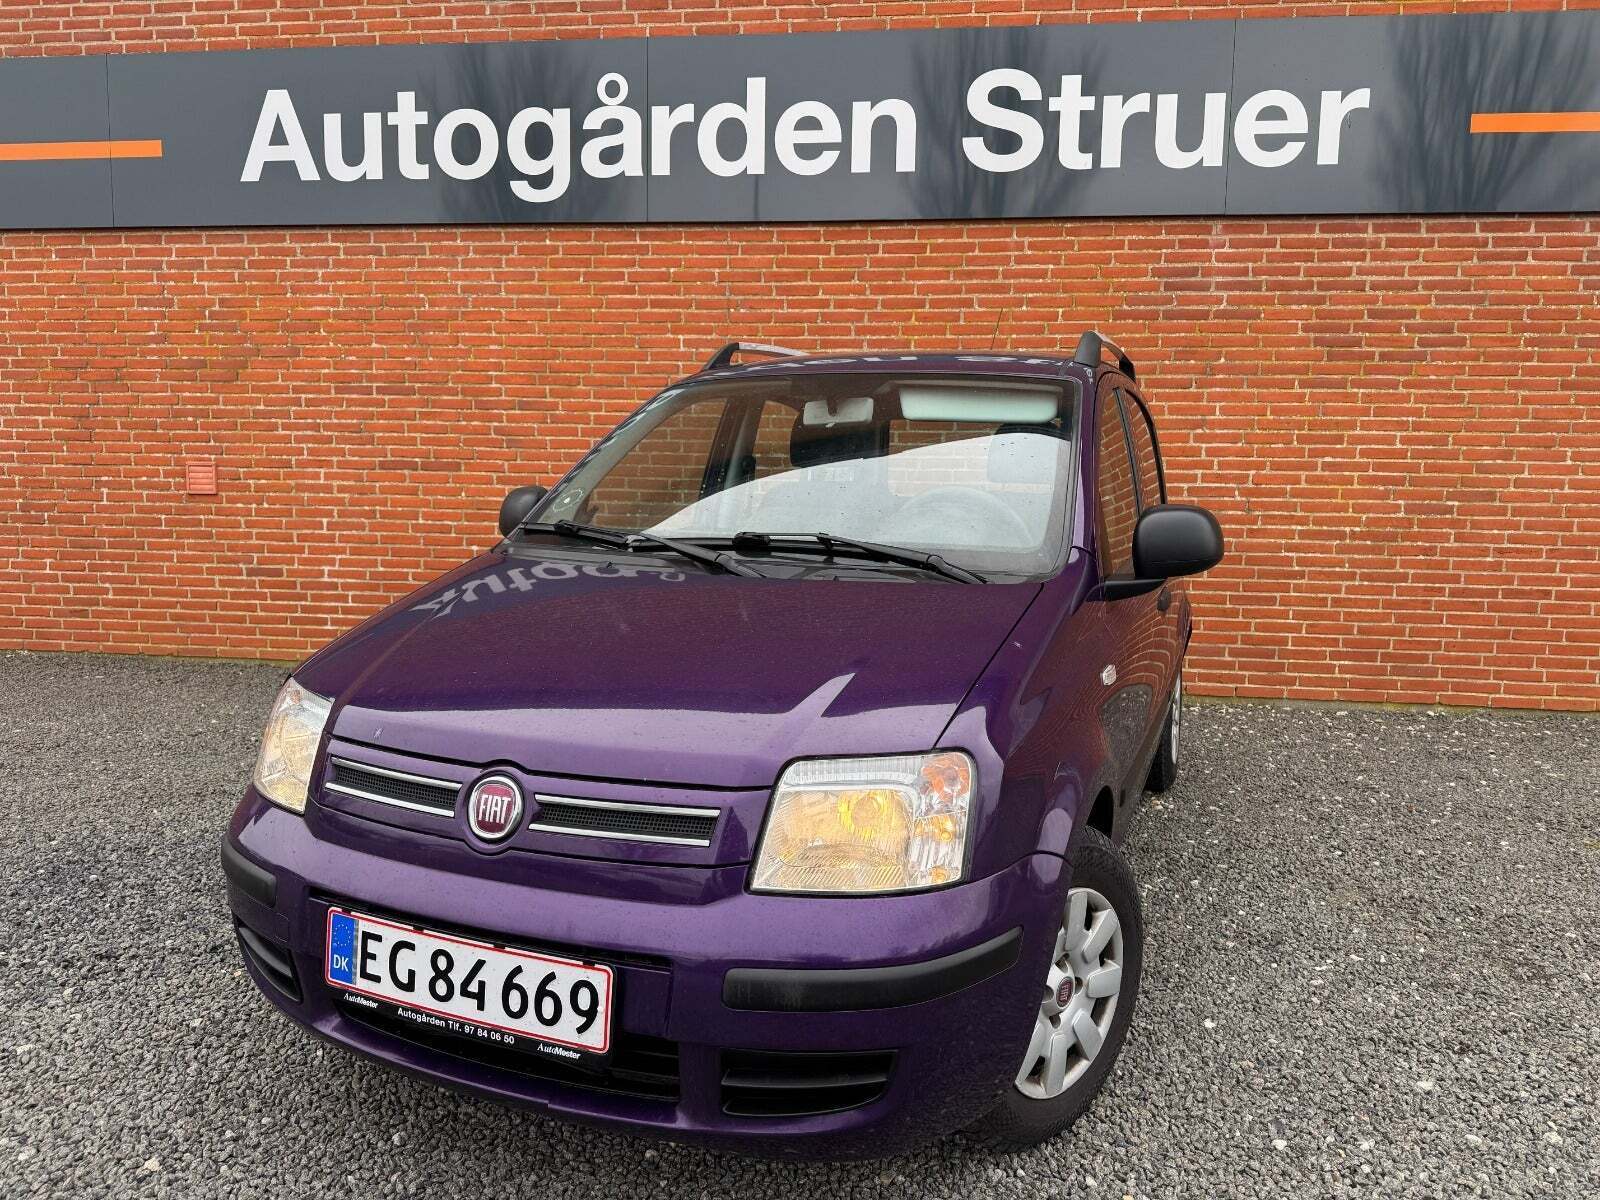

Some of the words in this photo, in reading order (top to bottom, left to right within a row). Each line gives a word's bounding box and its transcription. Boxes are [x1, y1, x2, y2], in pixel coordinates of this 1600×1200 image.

[240, 72, 918, 203] Autogården
[962, 68, 1371, 173] Struer
[478, 794, 512, 824] FIAT
[332, 954, 350, 973] DK
[359, 930, 416, 993] EG
[428, 948, 487, 1012] 84
[501, 964, 600, 1035] 669
[397, 1007, 446, 1028] Autogården
[447, 1020, 462, 1032] Tlf.
[464, 1026, 475, 1035] 97
[477, 1029, 488, 1039] 84
[490, 1033, 501, 1041] 06
[503, 1034, 515, 1045] 50
